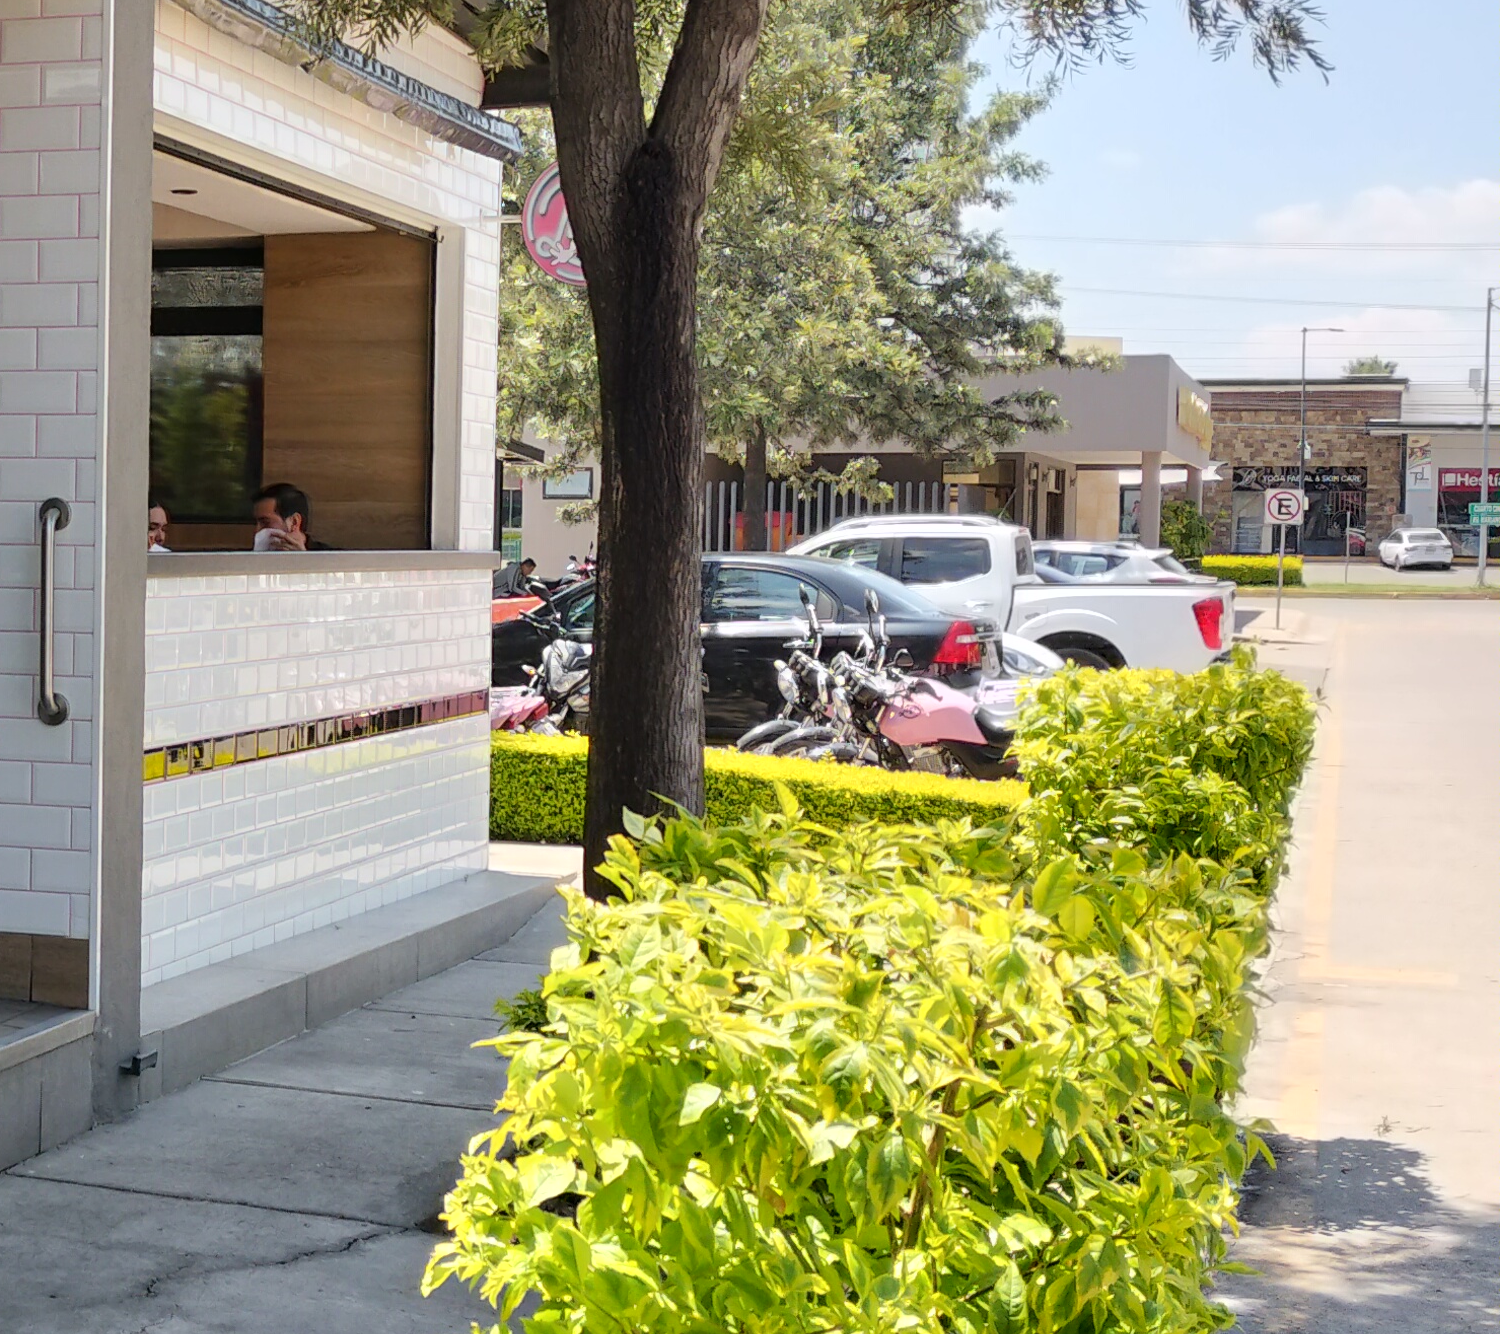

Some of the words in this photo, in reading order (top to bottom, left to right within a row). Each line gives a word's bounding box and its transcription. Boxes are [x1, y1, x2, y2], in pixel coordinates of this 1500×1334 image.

[1262, 474, 1286, 483] YOGA
[1287, 474, 1314, 483] FACAL
[1341, 474, 1361, 483] CARE
[1278, 498, 1293, 515] E
